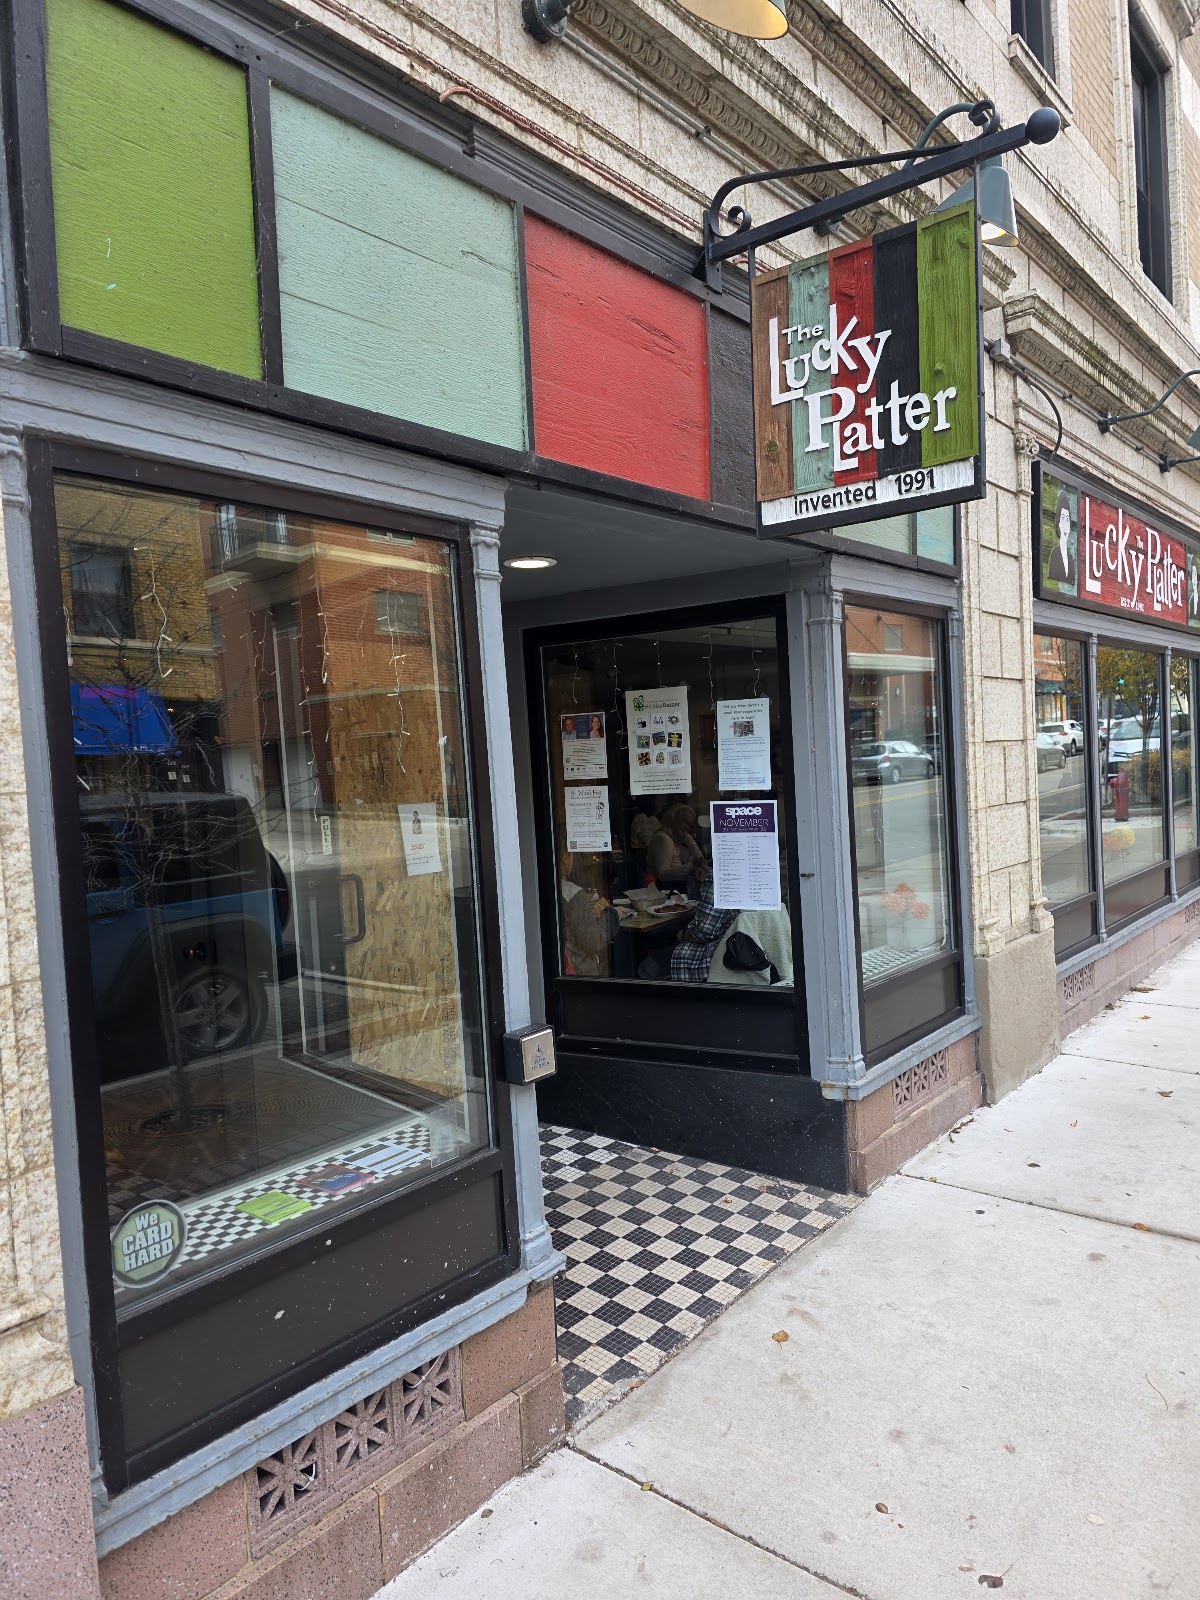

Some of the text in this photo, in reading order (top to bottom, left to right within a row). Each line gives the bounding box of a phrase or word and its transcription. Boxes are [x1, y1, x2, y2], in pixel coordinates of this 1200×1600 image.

[782, 324, 824, 346] The
[769, 303, 892, 406] Lucky
[794, 468, 935, 515] invented 1991
[1085, 496, 1145, 608] Lucky
[720, 818, 769, 827] NOVEMBER
[725, 806, 762, 818] space
[322, 818, 330, 843] PULL
[134, 1213, 158, 1230] We
[122, 1220, 172, 1254] CARD
[123, 1238, 173, 1271] HARD
